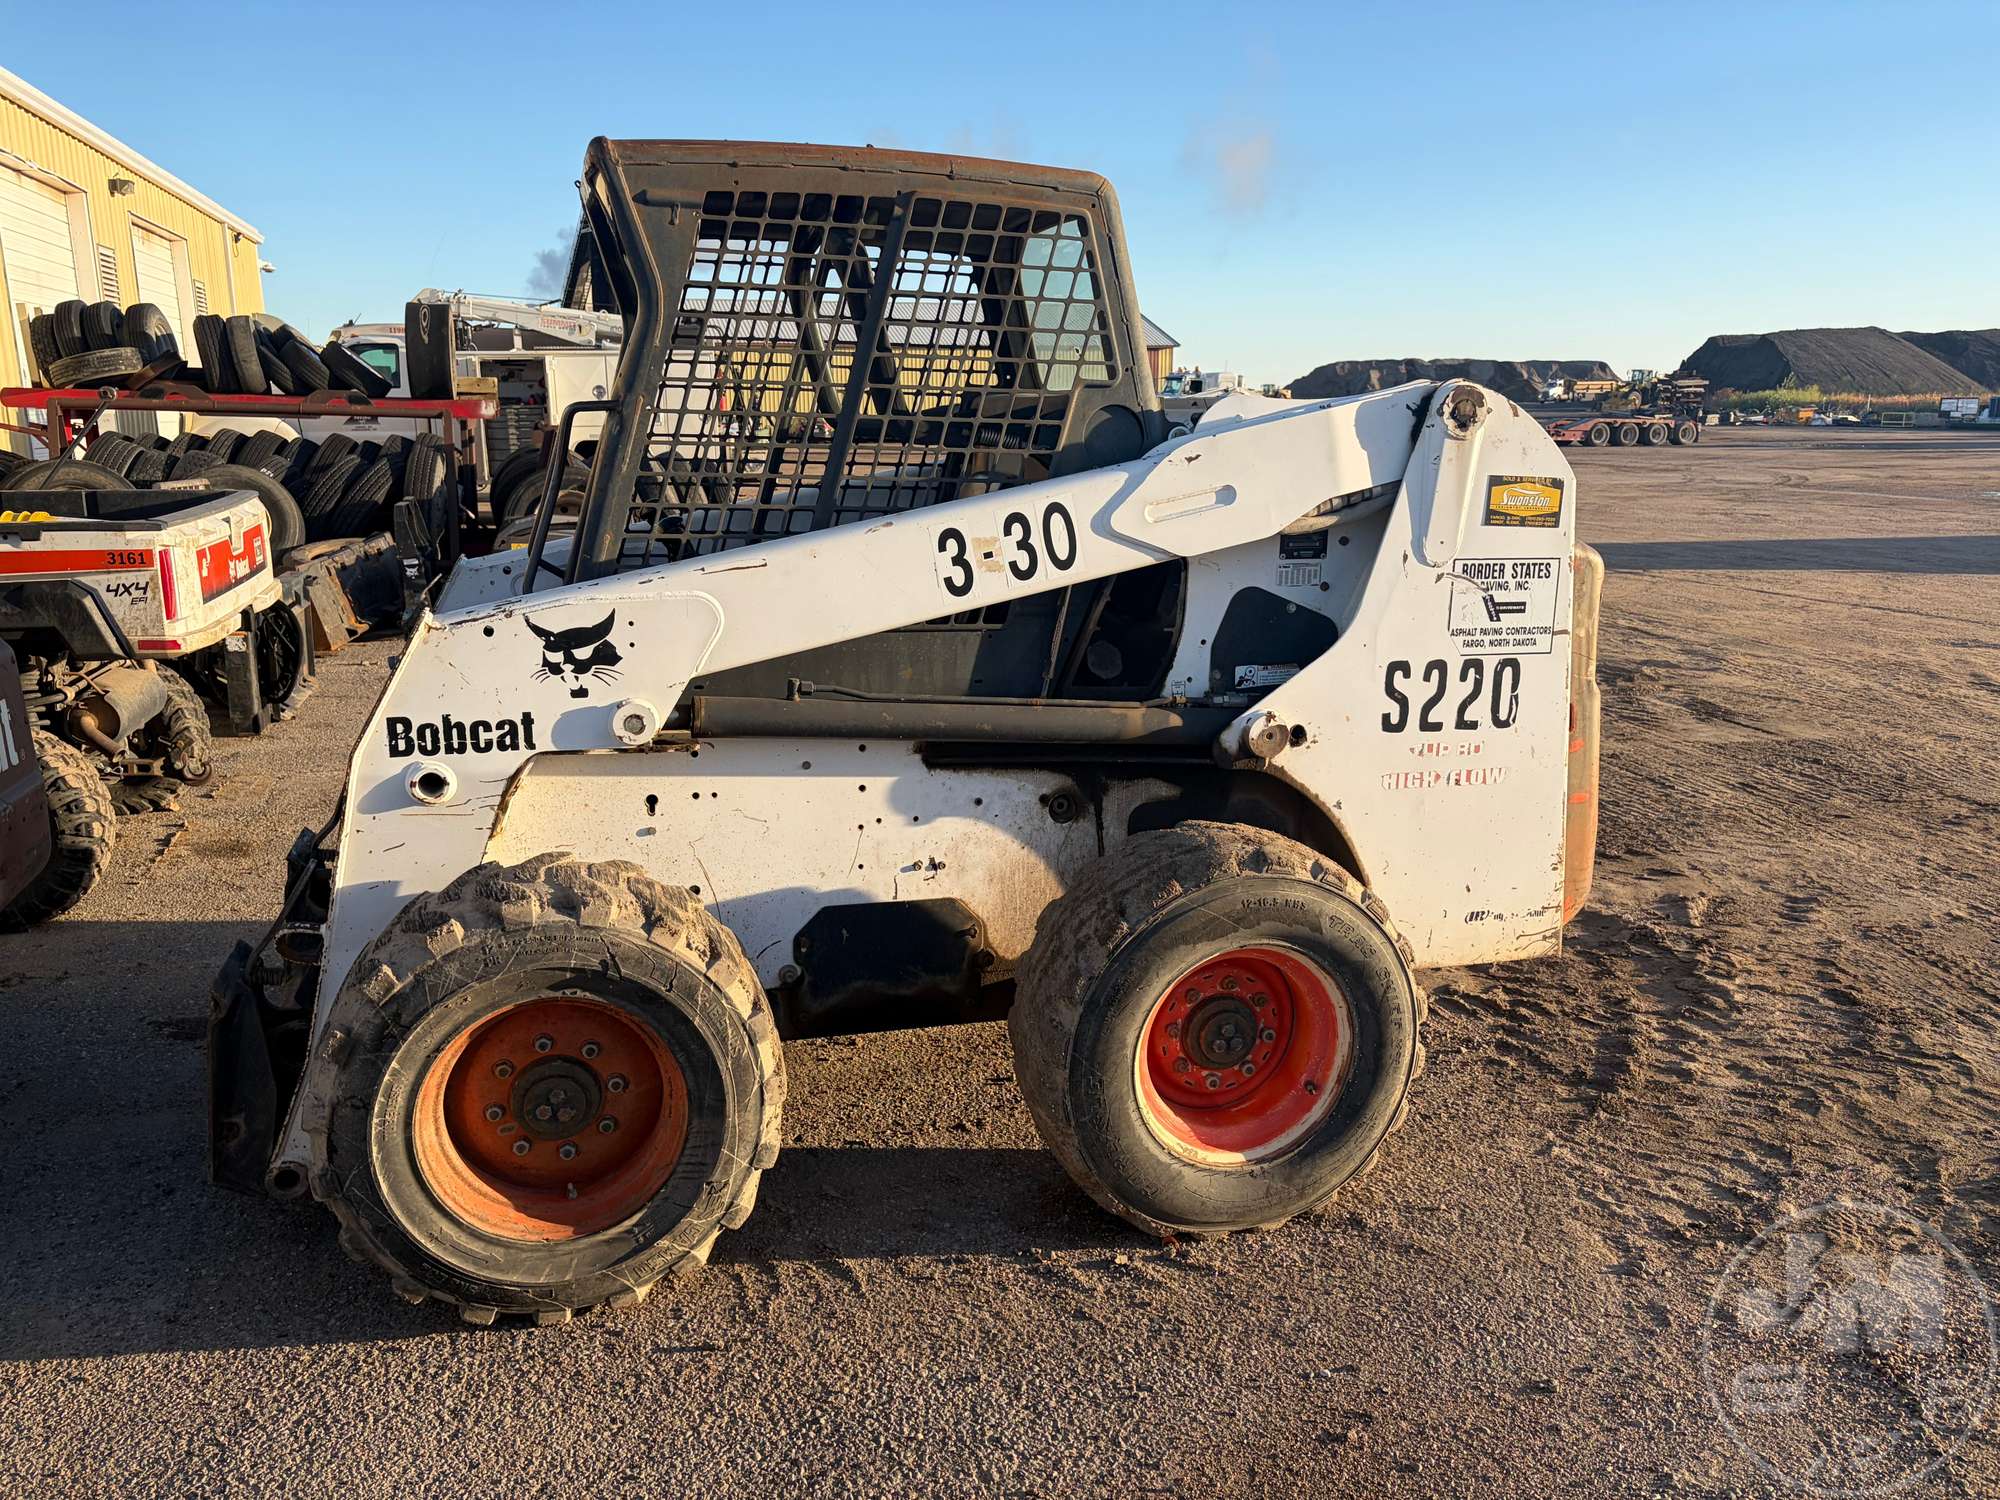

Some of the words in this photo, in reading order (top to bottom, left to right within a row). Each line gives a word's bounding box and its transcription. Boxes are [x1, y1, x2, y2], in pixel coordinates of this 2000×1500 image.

[1500, 487, 1551, 507] Swanston
[938, 501, 1077, 597] 3-30
[106, 551, 147, 565] 3161
[1462, 563, 1505, 579] BORDER
[1511, 562, 1552, 579] STATES
[106, 581, 149, 597] 4X4
[1514, 580, 1532, 591] INC.
[130, 596, 148, 605] EFI
[1450, 627, 1478, 637] ASPHALT
[1479, 627, 1504, 636] PAVING
[1505, 626, 1552, 636] CONTRACTORS
[1462, 639, 1487, 648] FARGO,
[1488, 639, 1511, 647] NORTH
[1512, 637, 1537, 647] DAKOTA
[1381, 657, 1521, 734] S220
[386, 711, 537, 758] Bobcat
